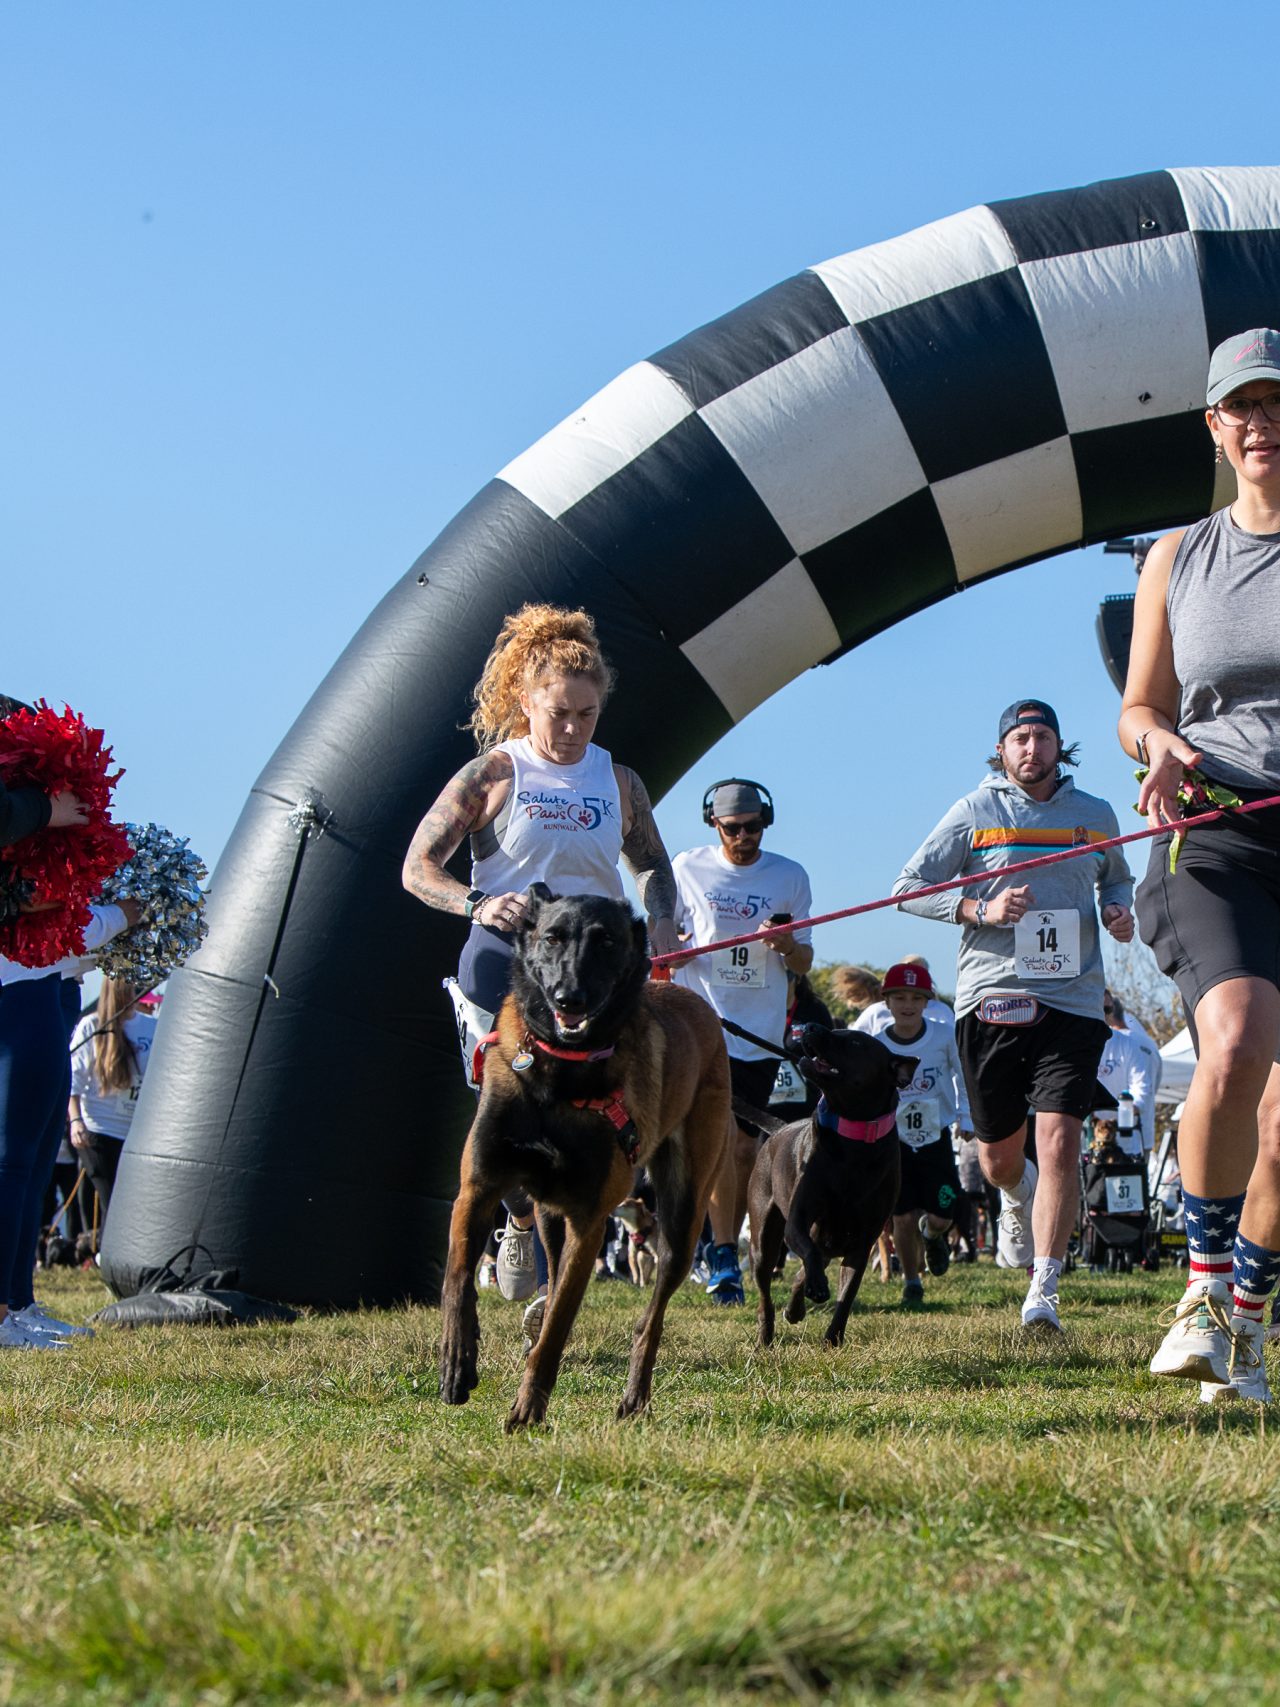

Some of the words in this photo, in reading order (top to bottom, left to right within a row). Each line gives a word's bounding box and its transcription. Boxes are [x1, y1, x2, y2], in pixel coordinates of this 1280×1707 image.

[517, 791, 569, 805] Salute
[525, 805, 567, 820] Paws
[582, 797, 616, 831] 5K
[746, 894, 773, 920] 5K
[1036, 927, 1058, 953] 14
[730, 946, 749, 967] 19
[1052, 953, 1071, 973] 5K
[986, 998, 1032, 1019] PADRES
[777, 1071, 793, 1088] 95
[905, 1112, 923, 1130] 18
[1118, 1185, 1130, 1199] 37
